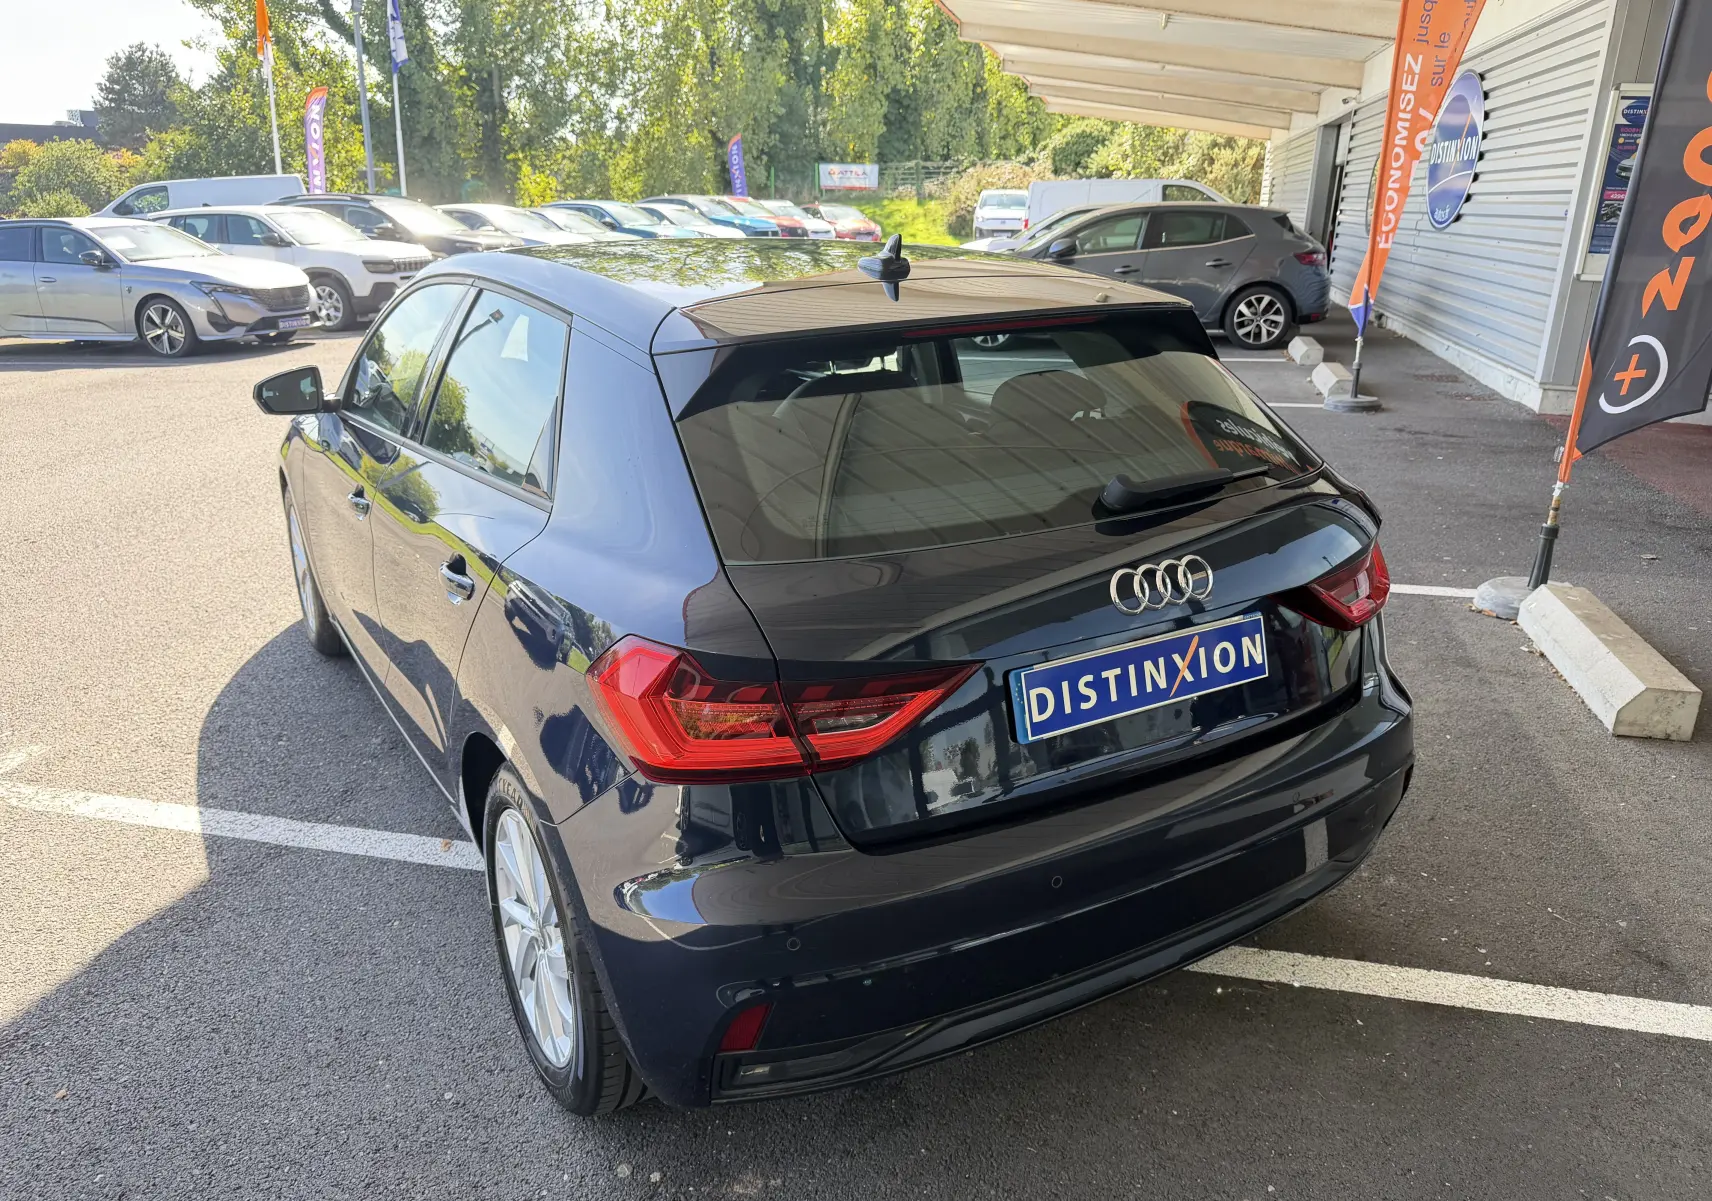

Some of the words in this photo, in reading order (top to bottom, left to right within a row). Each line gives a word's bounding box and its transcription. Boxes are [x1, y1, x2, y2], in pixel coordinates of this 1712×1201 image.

[1434, 31, 1451, 49] le
[1430, 55, 1446, 88] sur
[1378, 53, 1423, 249] ÉCONOMISEZ
[1430, 133, 1479, 166] DISTINXION
[1029, 633, 1264, 723] DISTINXION
